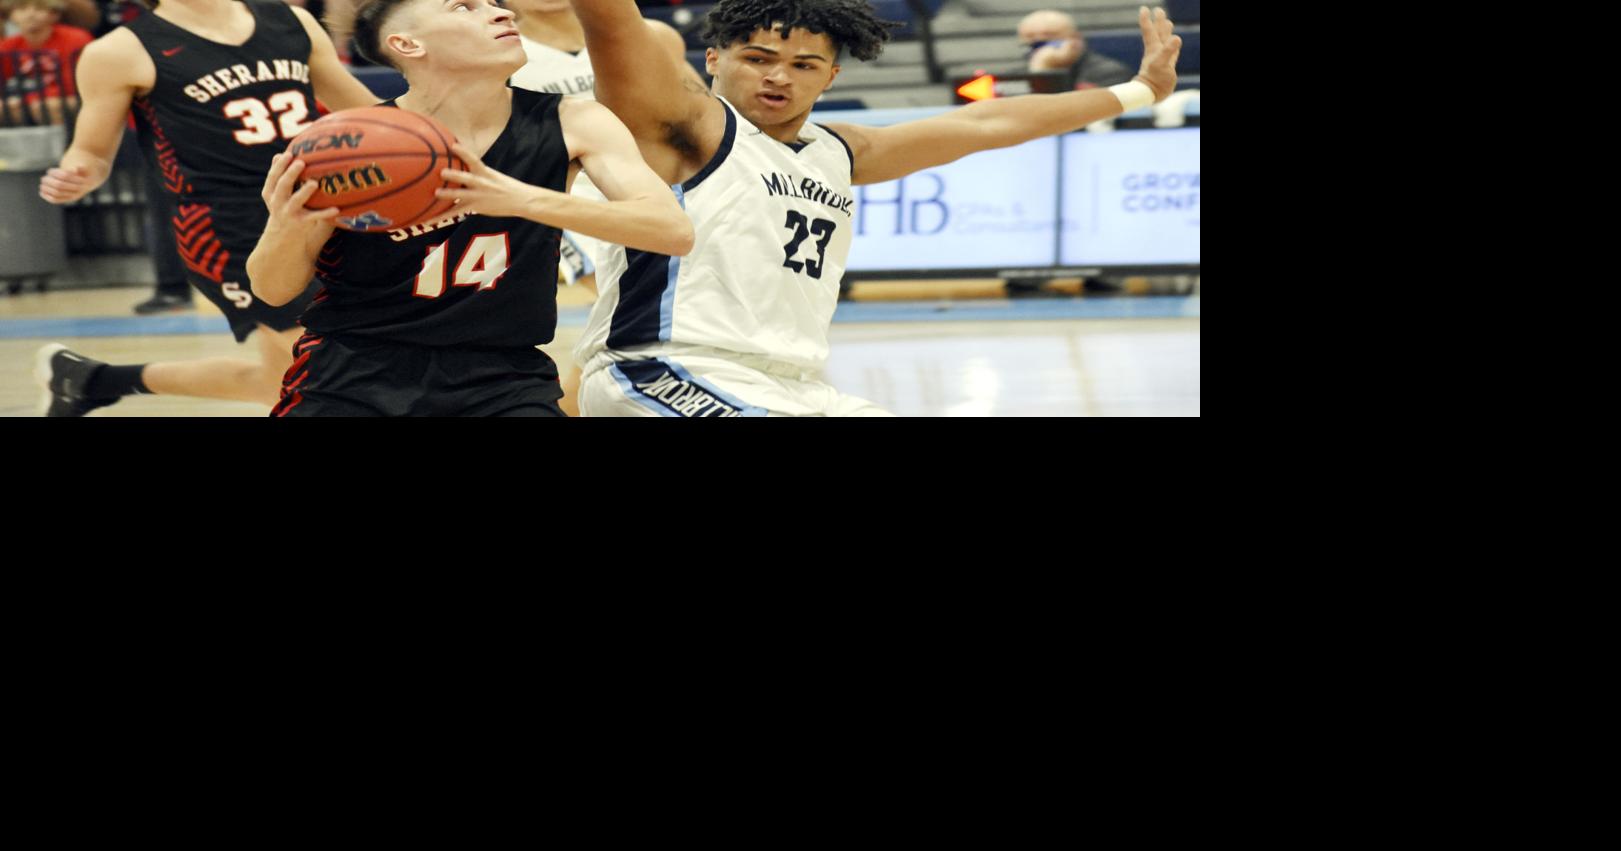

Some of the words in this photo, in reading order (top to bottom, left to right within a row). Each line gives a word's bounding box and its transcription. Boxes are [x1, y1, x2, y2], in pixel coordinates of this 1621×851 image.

[223, 90, 314, 146] 32
[411, 230, 511, 299] 14
[782, 209, 837, 280] 23
[222, 282, 252, 309] S
